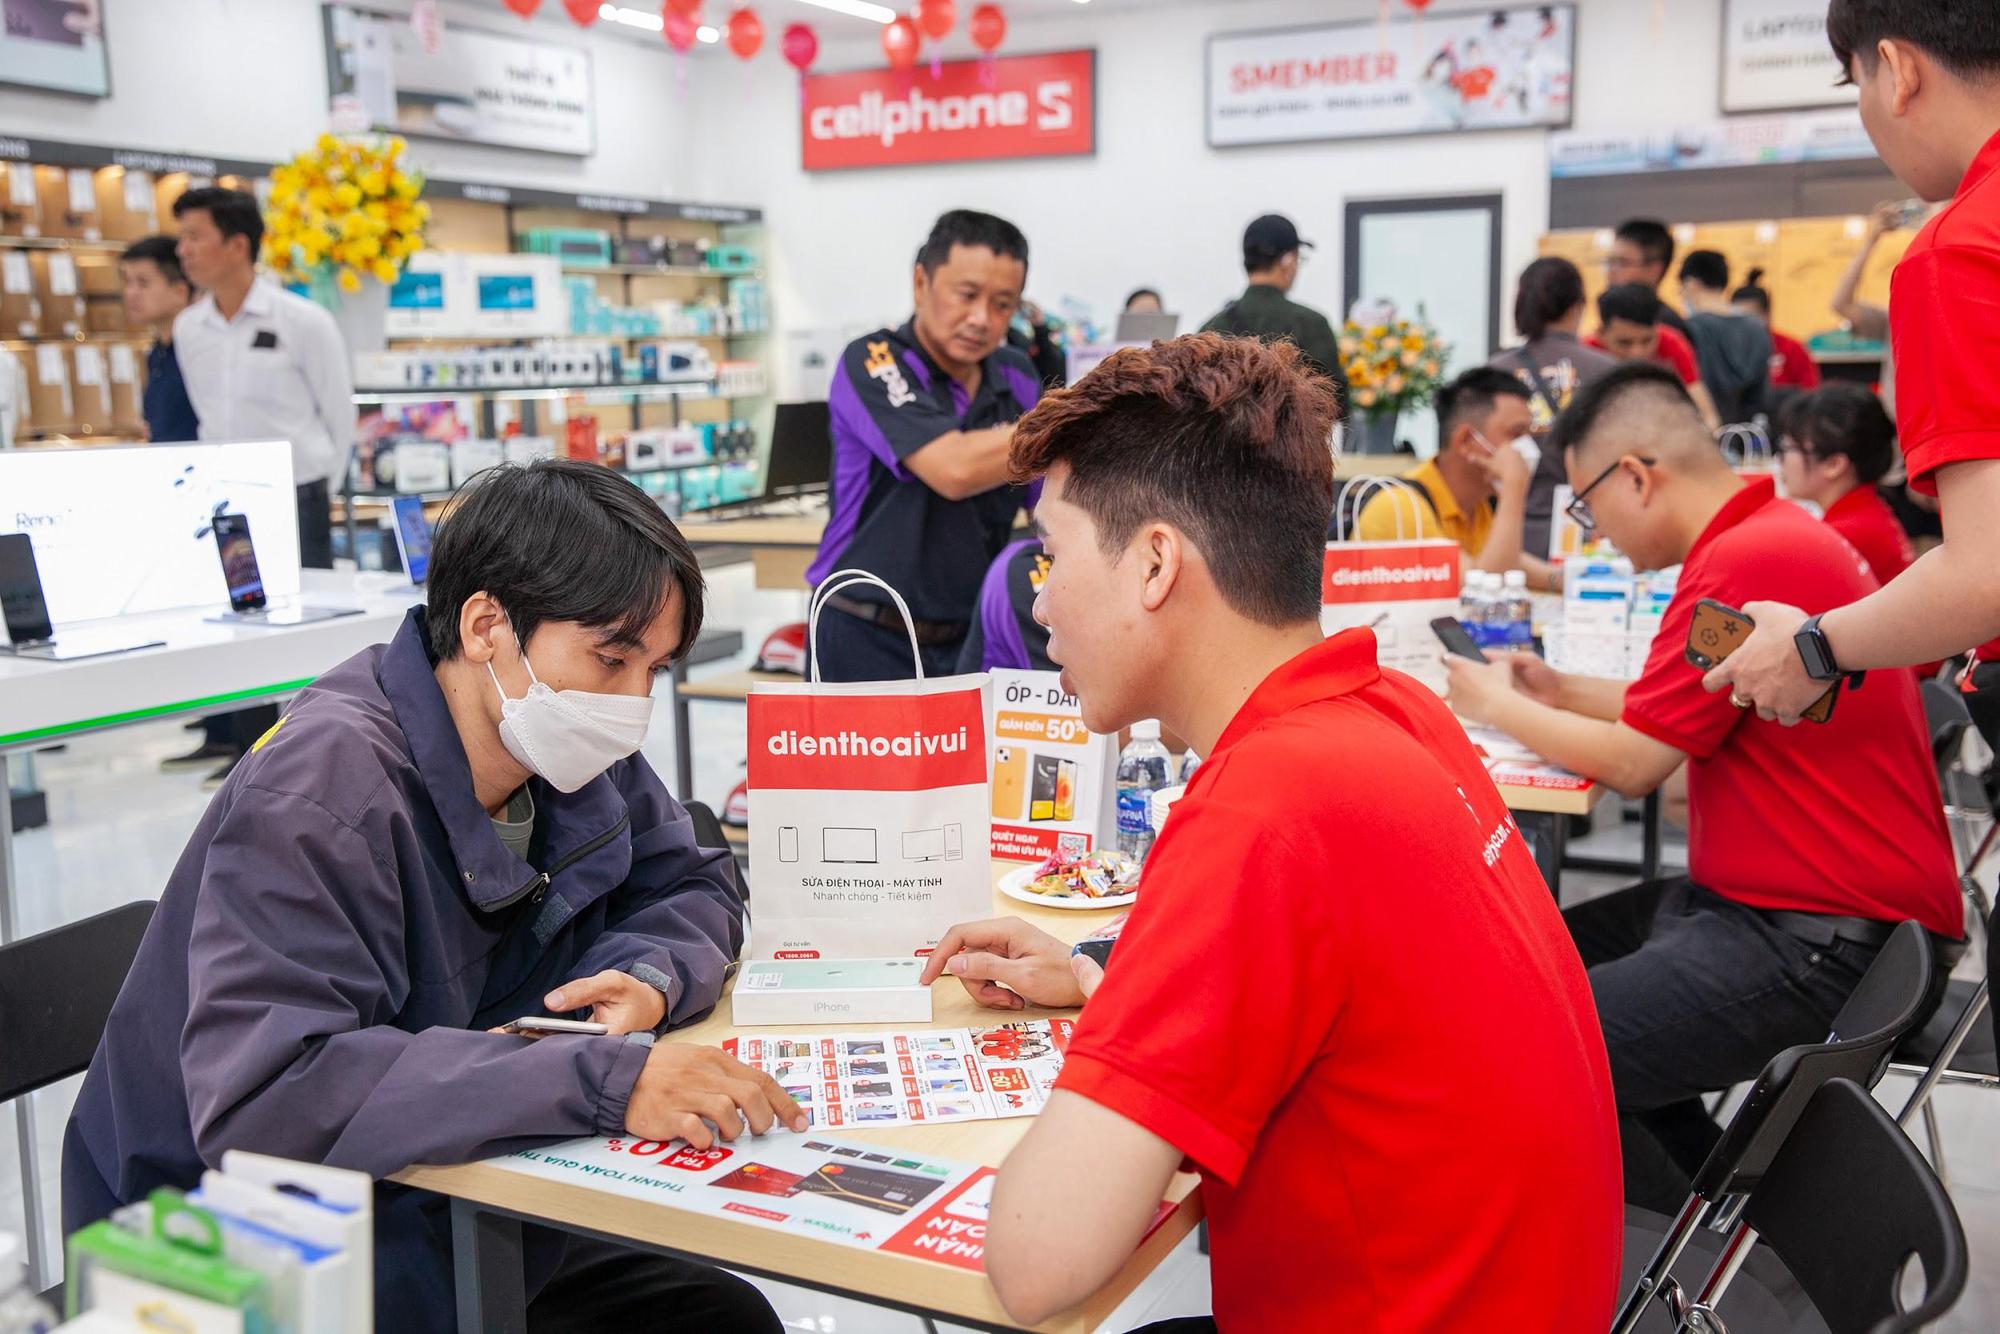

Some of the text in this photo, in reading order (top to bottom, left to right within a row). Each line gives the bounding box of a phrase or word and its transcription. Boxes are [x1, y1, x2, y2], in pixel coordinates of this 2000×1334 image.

[1232, 50, 1398, 95] SMEMBER
[811, 86, 1027, 147] cellphone
[1332, 562, 1450, 587] dienthoaivui
[1006, 679, 1032, 703] ỐP
[767, 726, 967, 757] dienthoaivui
[1015, 833, 1040, 844] NGAY
[801, 876, 823, 887] SỬA
[826, 877, 850, 889] ĐIỆN
[853, 878, 884, 890] THOẠI
[893, 876, 915, 888] MÁY
[917, 876, 942, 887] TÍNH
[813, 891, 846, 901] Nhanh
[848, 891, 879, 903] chóng
[888, 891, 905, 901] Tiết
[908, 891, 932, 902] kiệm
[814, 1001, 850, 1012] iPhone
[545, 1156, 580, 1169] QUA
[669, 1155, 706, 1169] TRẢ
[582, 1164, 626, 1180] TOÁN
[629, 1174, 686, 1193] THANH
[926, 1216, 987, 1239] OÁN
